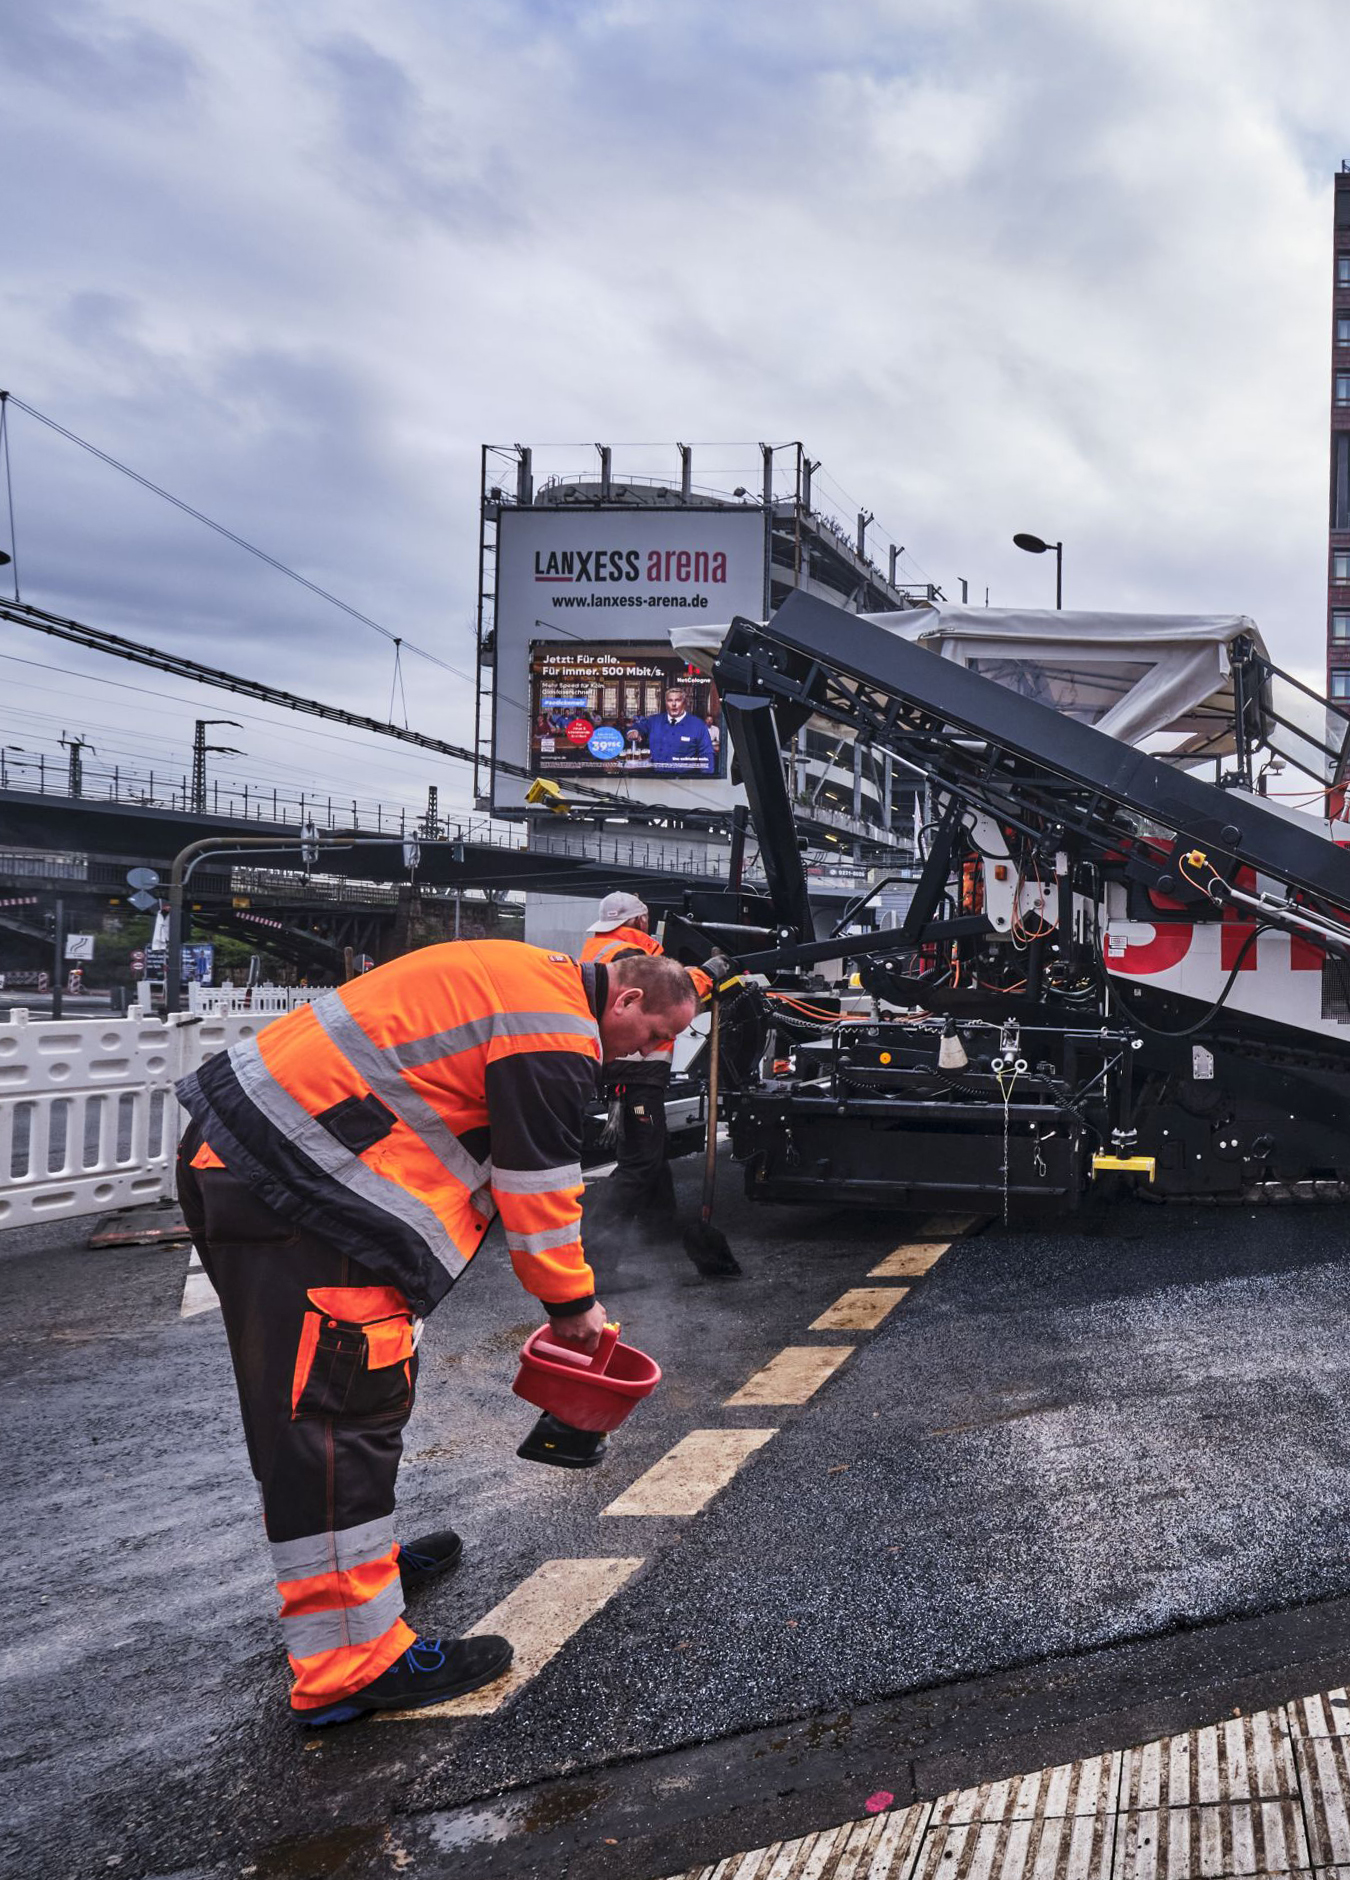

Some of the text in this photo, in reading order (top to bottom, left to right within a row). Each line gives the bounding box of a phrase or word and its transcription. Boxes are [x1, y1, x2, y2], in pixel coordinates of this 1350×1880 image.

[534, 550, 727, 583] LANXESS arena
[552, 593, 708, 608] www.lanxess-arena.de
[543, 655, 620, 664] Jetzt: Für alle.
[542, 665, 665, 677] Für immer. 500 Mbit/s.
